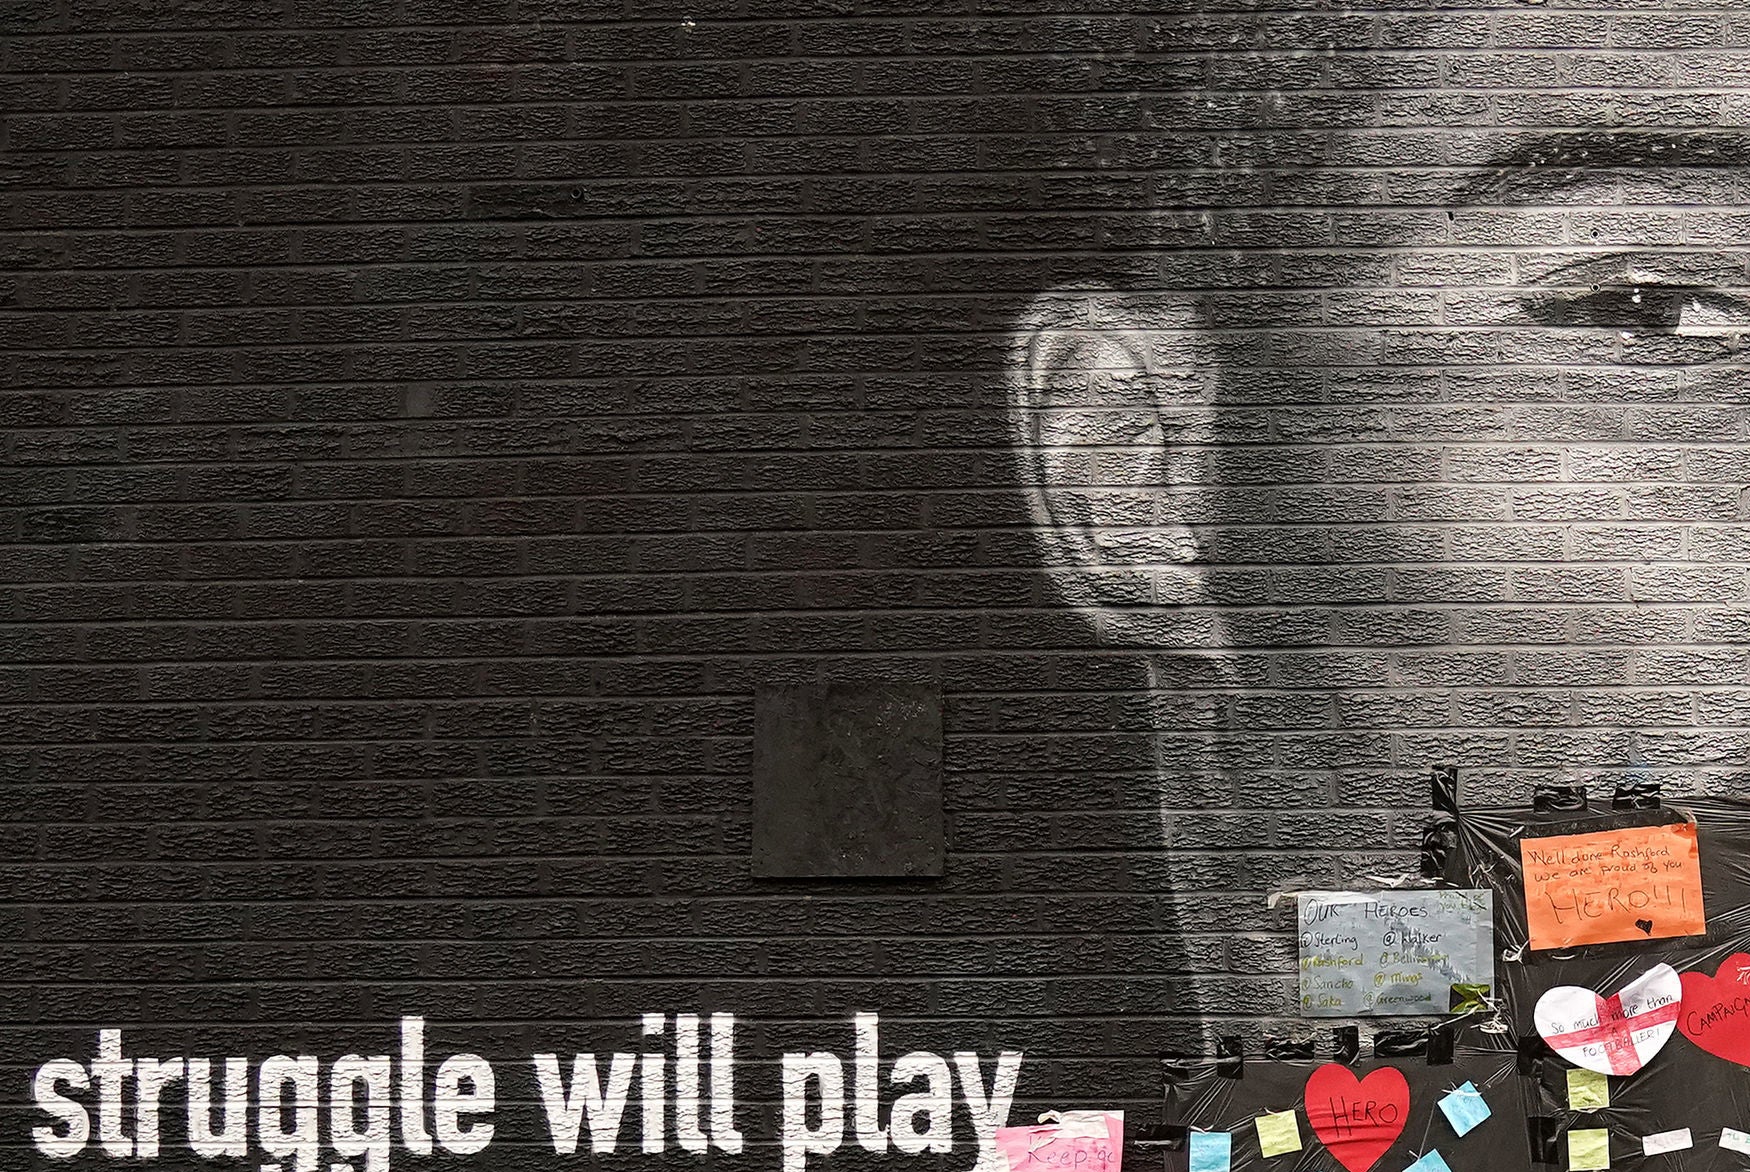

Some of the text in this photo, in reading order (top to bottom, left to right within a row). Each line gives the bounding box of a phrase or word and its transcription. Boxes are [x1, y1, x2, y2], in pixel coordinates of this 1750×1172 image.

[1528, 850, 1565, 865] Well
[1364, 901, 1428, 918] HEROES
[1573, 1015, 1602, 1031] much
[1611, 1004, 1638, 1021] more
[1647, 994, 1673, 1009] than
[531, 1012, 742, 1156] will
[1330, 1096, 1398, 1138] HERO
[1028, 1136, 1088, 1171] Keep
